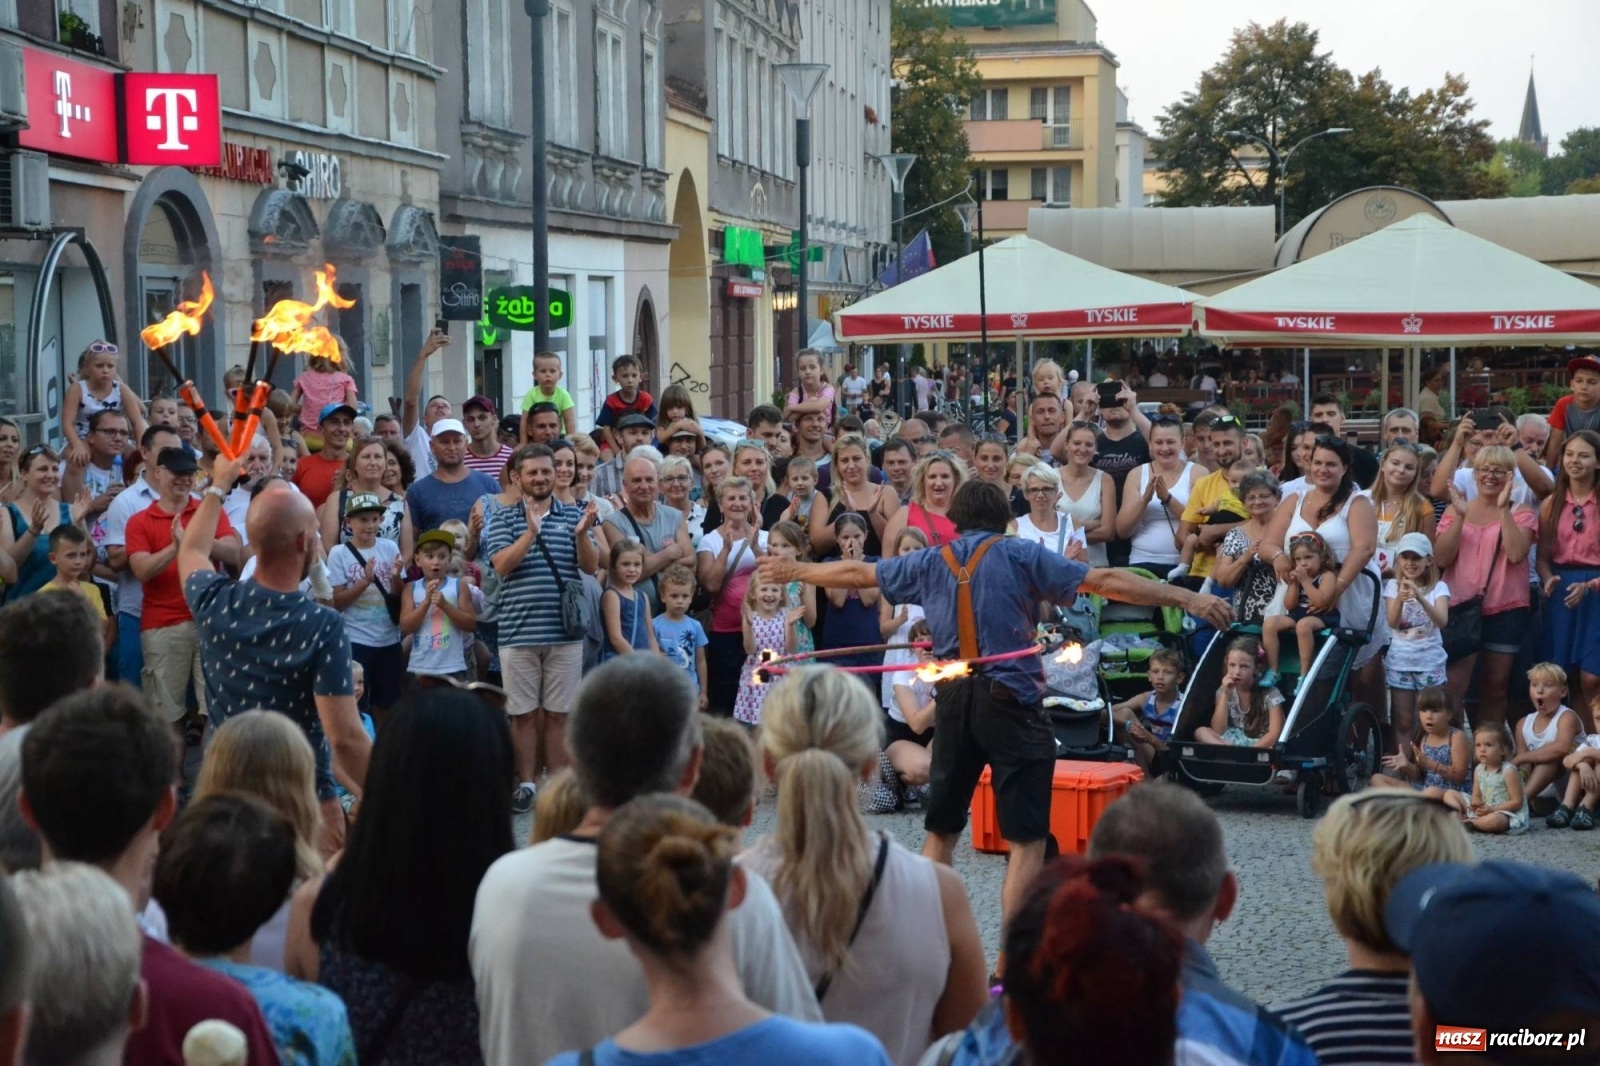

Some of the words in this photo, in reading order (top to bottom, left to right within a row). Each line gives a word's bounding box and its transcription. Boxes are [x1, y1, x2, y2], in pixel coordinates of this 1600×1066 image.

[145, 88, 198, 150] T
[188, 142, 273, 184] AURACJA
[295, 150, 341, 199] SHIRO
[496, 295, 563, 316] żaba
[901, 314, 955, 329] TYSKIE
[1084, 307, 1138, 323] TYSKIE
[1274, 316, 1336, 330] TYSKIE
[1490, 315, 1556, 330] TYSKIE
